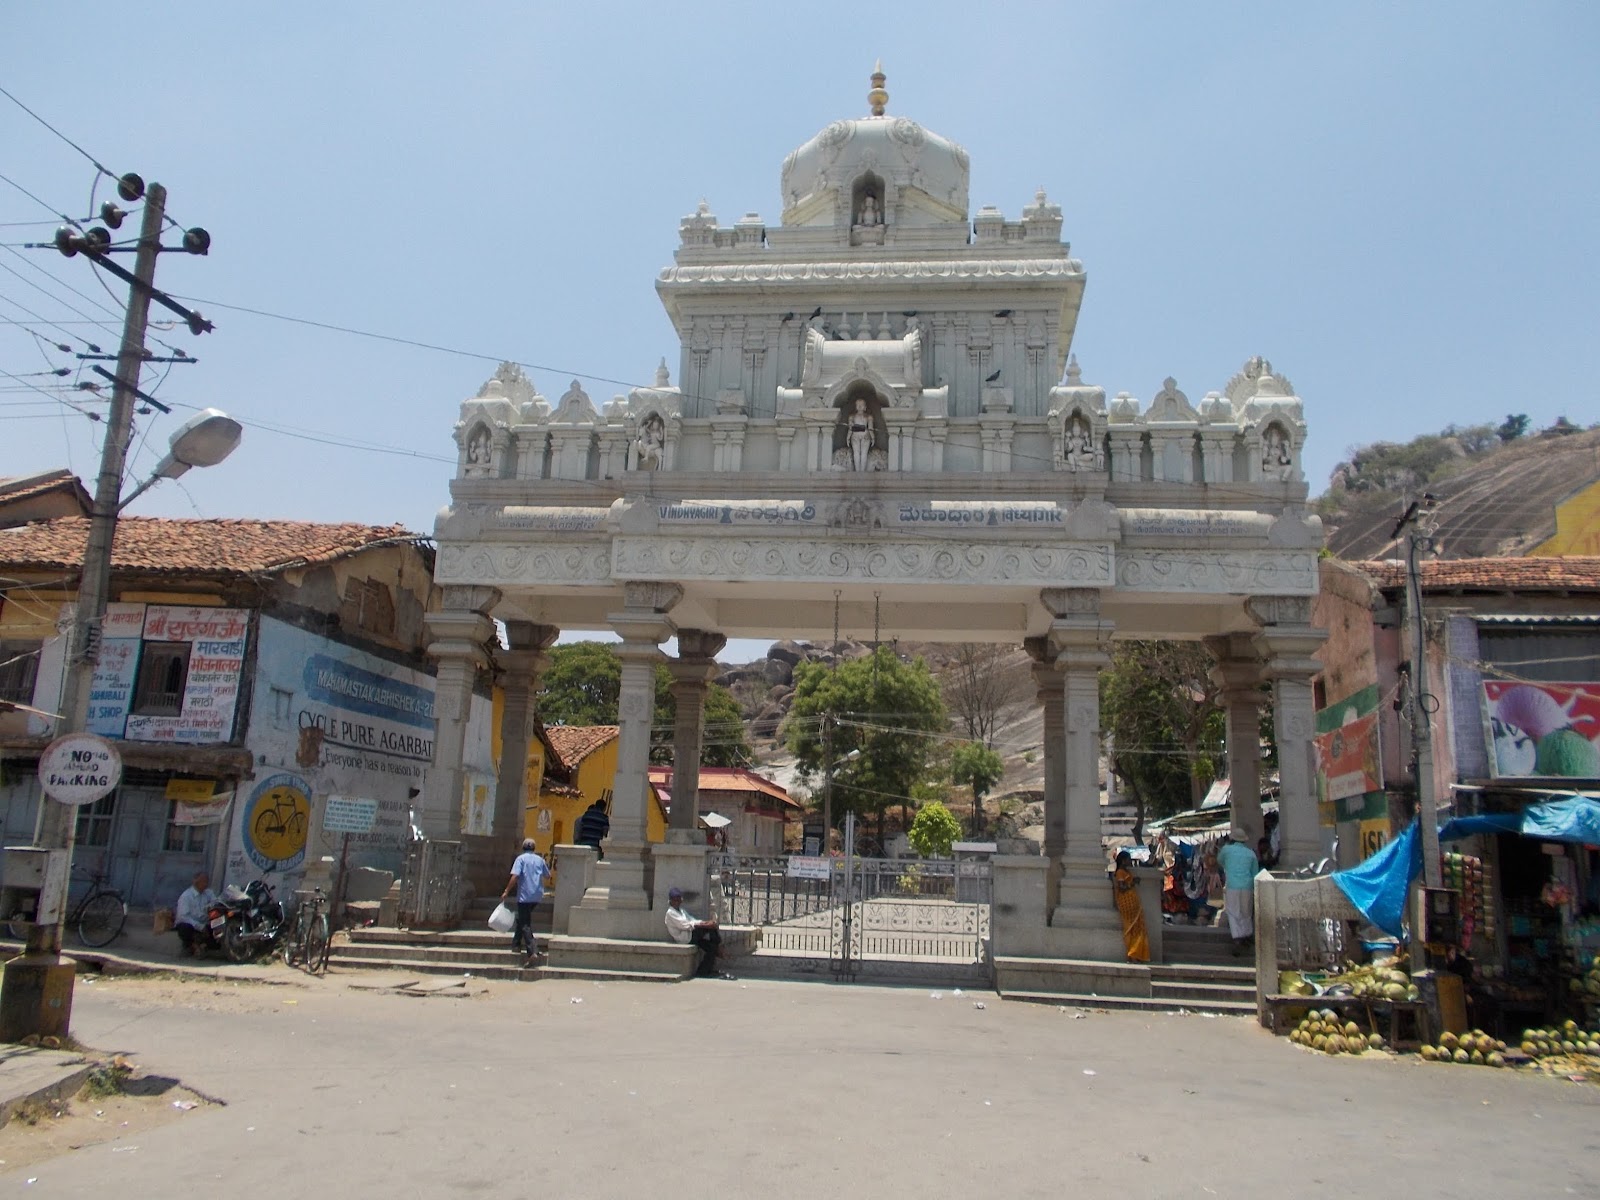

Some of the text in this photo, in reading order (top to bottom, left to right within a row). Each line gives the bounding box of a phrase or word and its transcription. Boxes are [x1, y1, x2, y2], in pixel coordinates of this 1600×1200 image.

[659, 506, 718, 519] VINDHYAGIRI
[99, 707, 122, 718] SHOP
[298, 710, 338, 739] CYCLE
[342, 721, 375, 746] PURE
[71, 750, 92, 762] NO
[325, 748, 362, 770] Everyone
[365, 755, 379, 772] has
[381, 762, 386, 772] a
[388, 762, 412, 776] reason
[414, 766, 421, 778] to
